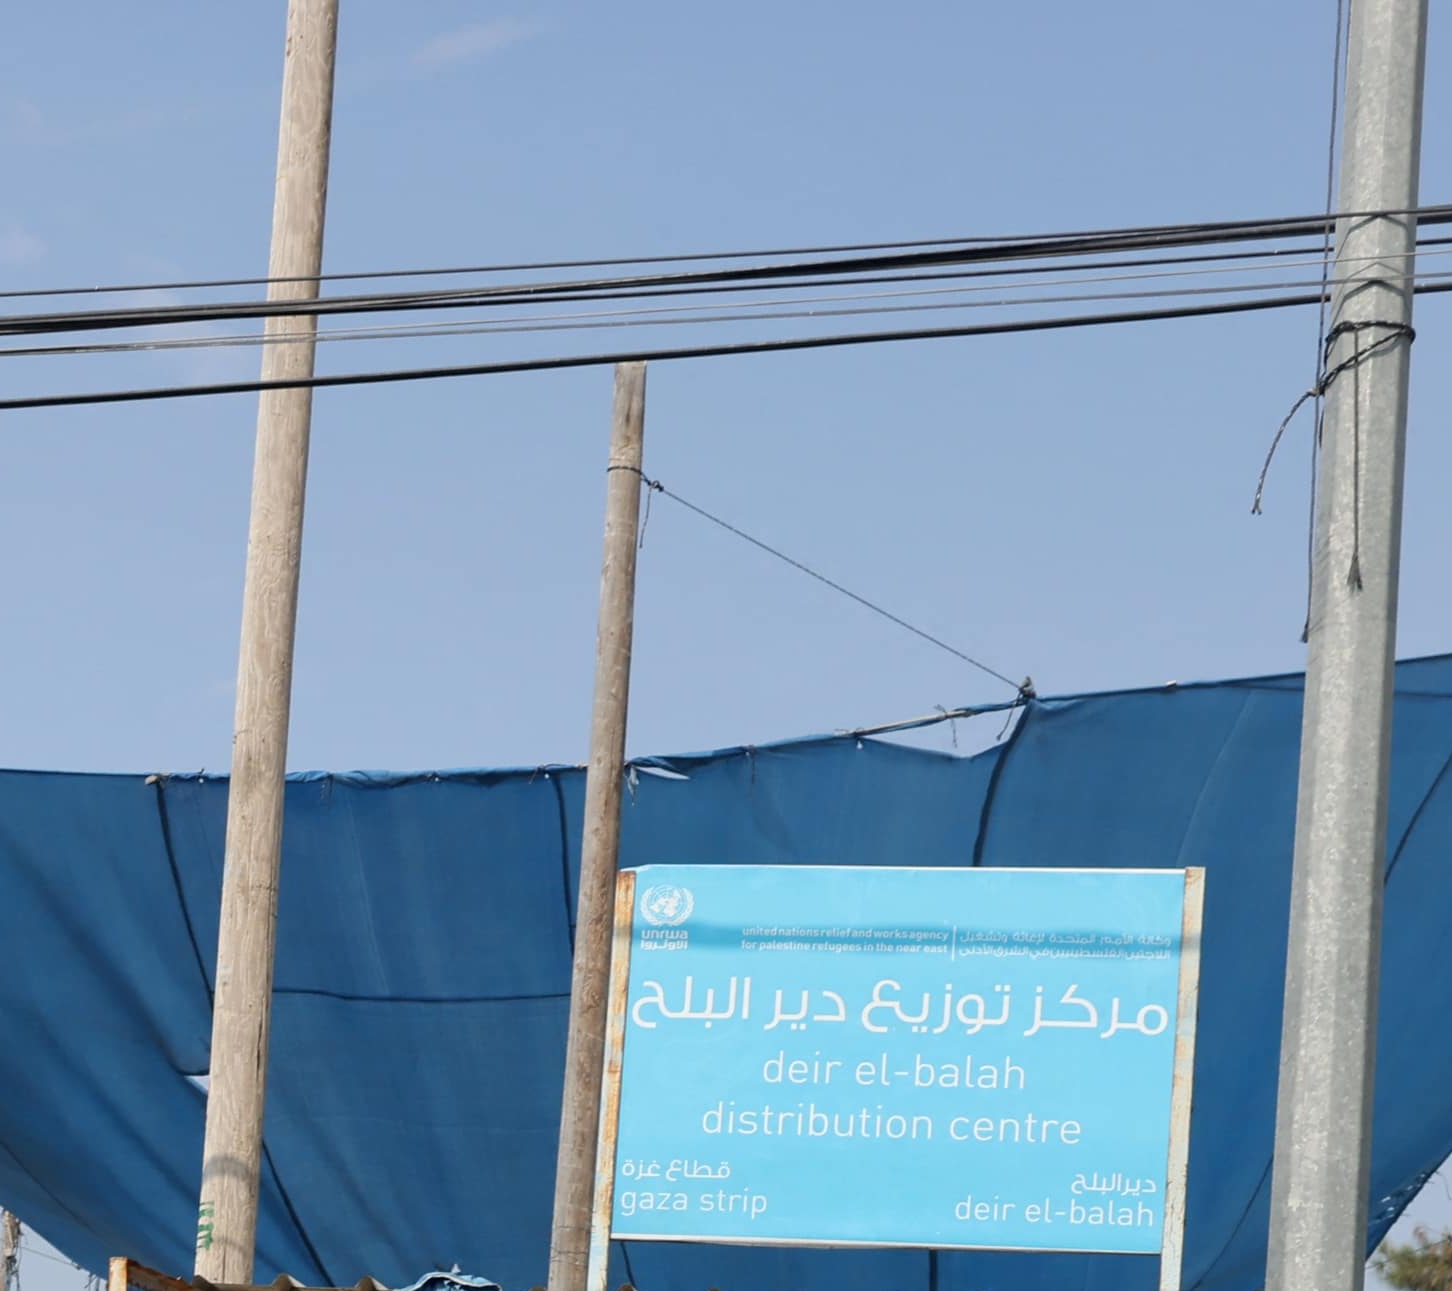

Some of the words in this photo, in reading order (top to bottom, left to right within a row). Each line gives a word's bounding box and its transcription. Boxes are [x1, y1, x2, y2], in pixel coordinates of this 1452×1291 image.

[641, 928, 689, 940] unrwa
[742, 925, 777, 937] united
[778, 926, 820, 938] nations
[851, 928, 872, 939] and
[908, 931, 948, 942] agency
[742, 939, 757, 950] for
[759, 941, 811, 952] palestine
[812, 941, 862, 953] refugees
[863, 941, 874, 951] in
[876, 941, 894, 952] the
[896, 944, 921, 953] near
[923, 943, 948, 953] east
[631, 975, 752, 1029] البلح
[763, 989, 846, 1031] دير
[861, 979, 1012, 1035] توزيع
[1023, 984, 1169, 1039] مركز
[762, 1050, 843, 1085] deir
[854, 1052, 1026, 1090] el-balah
[701, 1100, 933, 1140] distribution
[948, 1112, 1082, 1145] centre
[621, 1159, 661, 1181] غزة
[665, 1159, 731, 1182] قطاع
[621, 1191, 689, 1217] gaza
[699, 1187, 768, 1220] strip
[954, 1194, 1016, 1221] deir
[1024, 1197, 1154, 1227] el-balah
